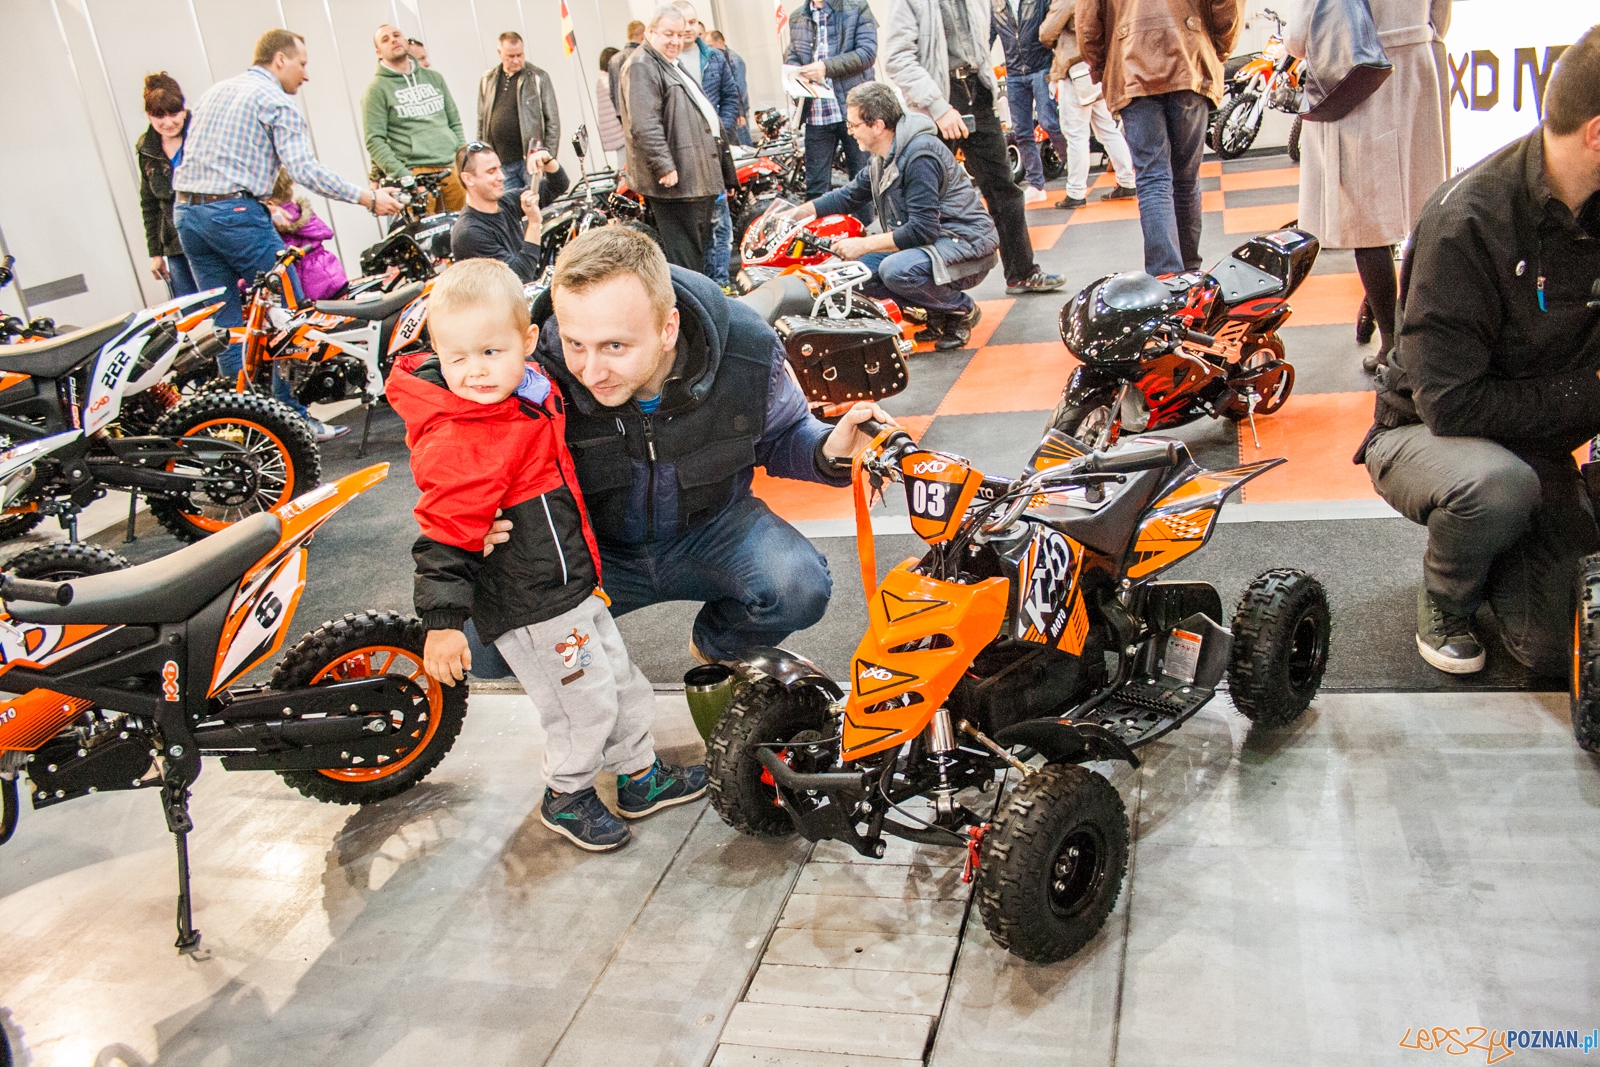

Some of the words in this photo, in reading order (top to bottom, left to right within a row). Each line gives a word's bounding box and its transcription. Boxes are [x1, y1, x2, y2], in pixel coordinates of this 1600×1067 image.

[400, 318, 418, 339] 222
[101, 350, 132, 390] 222
[913, 459, 947, 475] KXD
[912, 480, 946, 517] 03
[975, 486, 995, 499] TO
[1050, 608, 1067, 638] MOTO
[162, 660, 179, 702] KXD
[858, 667, 893, 681] KXD
[0, 707, 17, 727] TO
